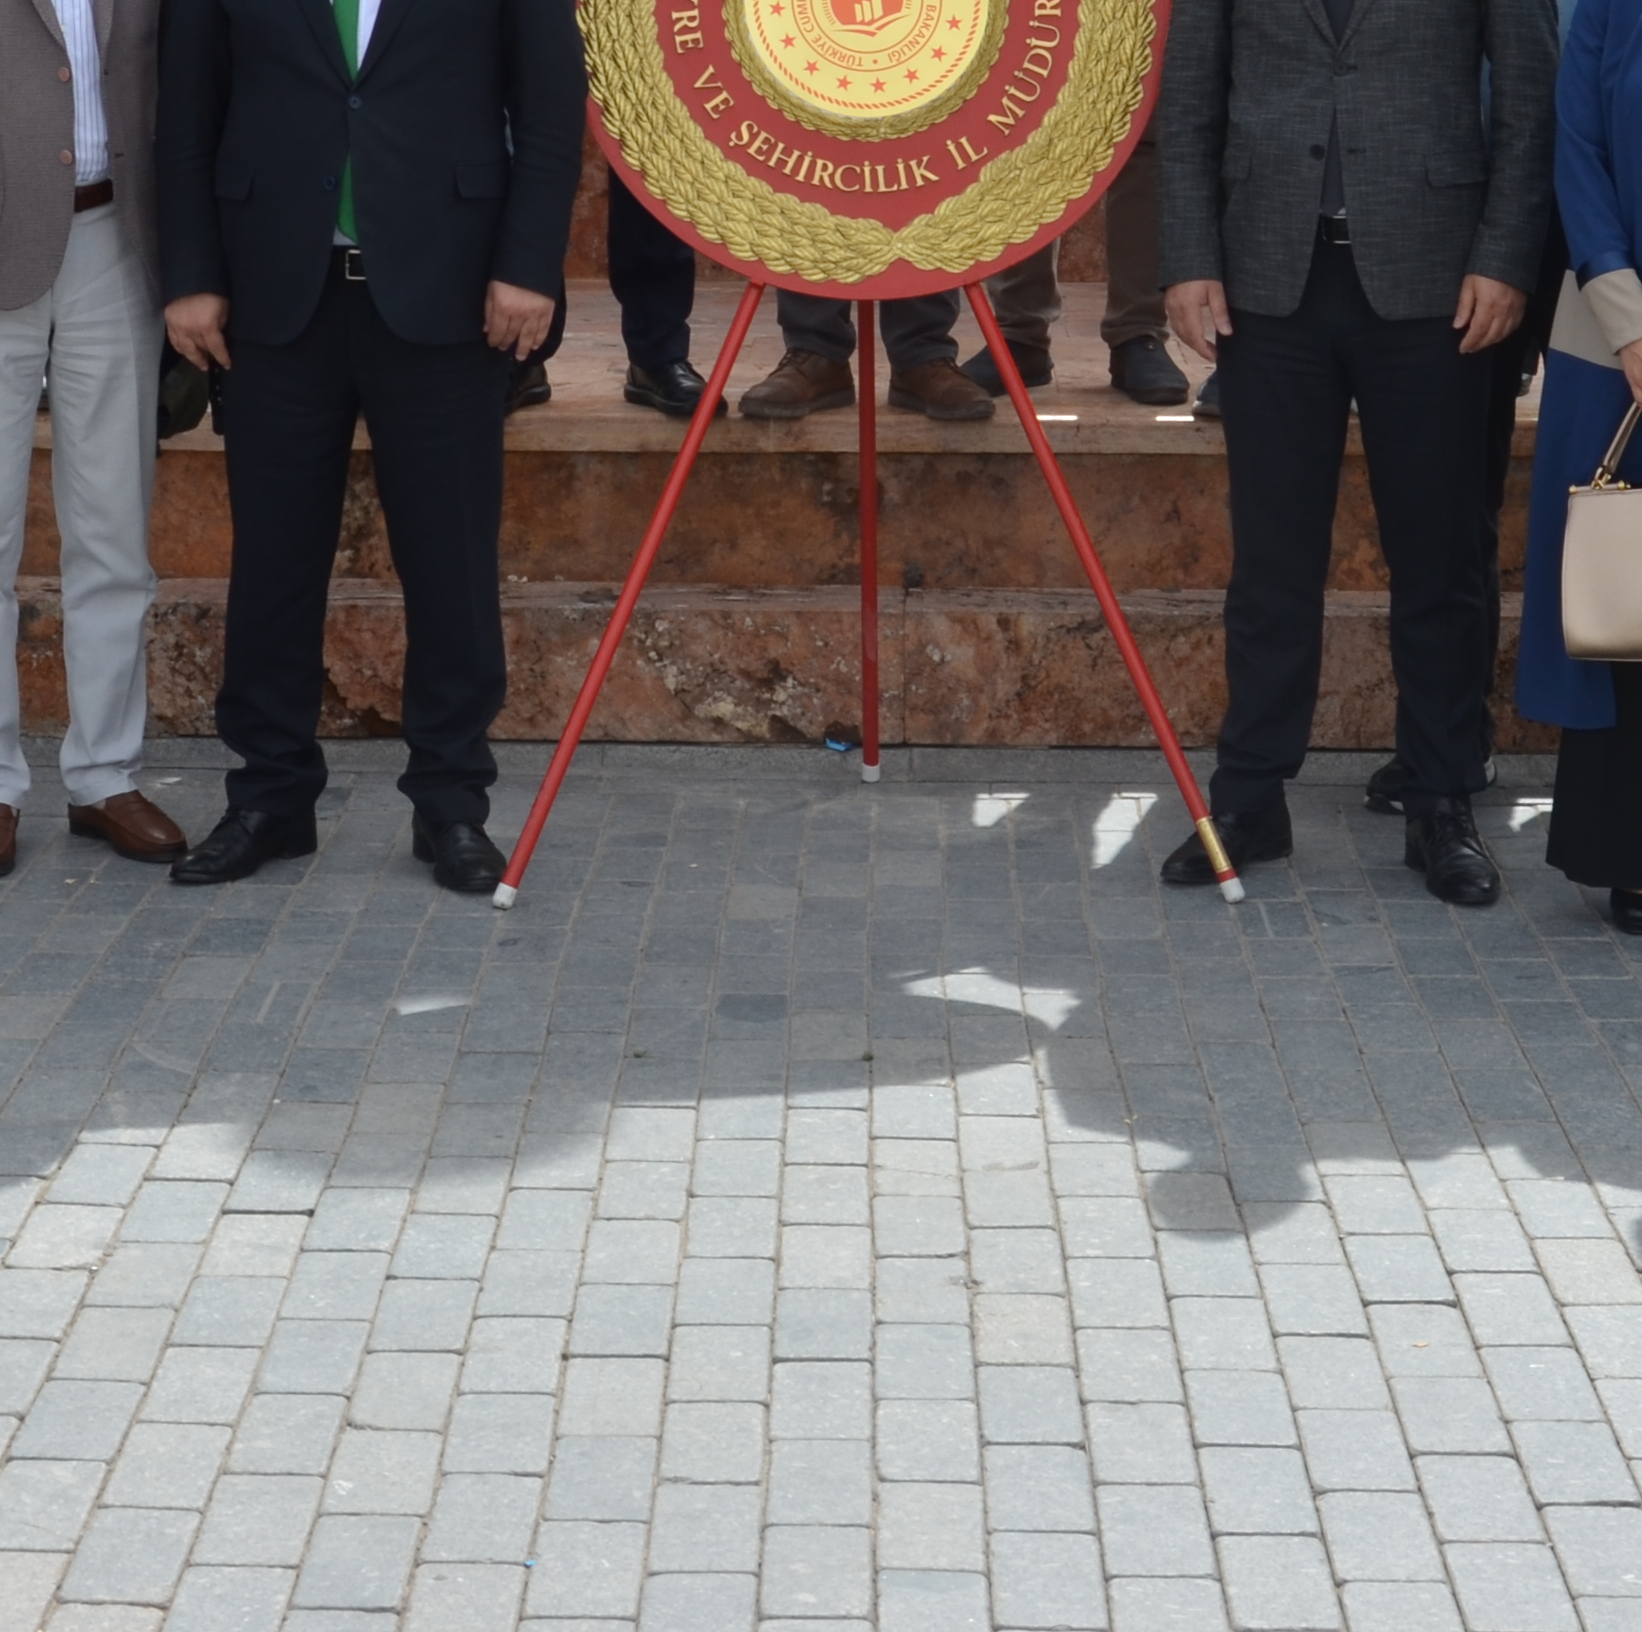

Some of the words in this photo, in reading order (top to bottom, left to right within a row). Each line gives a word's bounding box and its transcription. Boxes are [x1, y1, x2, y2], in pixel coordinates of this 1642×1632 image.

[811, 35, 864, 67] TÜRKİYE
[887, 4, 937, 63] BAKANLIĞI
[692, 65, 735, 119] VE
[729, 120, 939, 192] ŞEHİRCİLİK
[946, 137, 988, 171] İL
